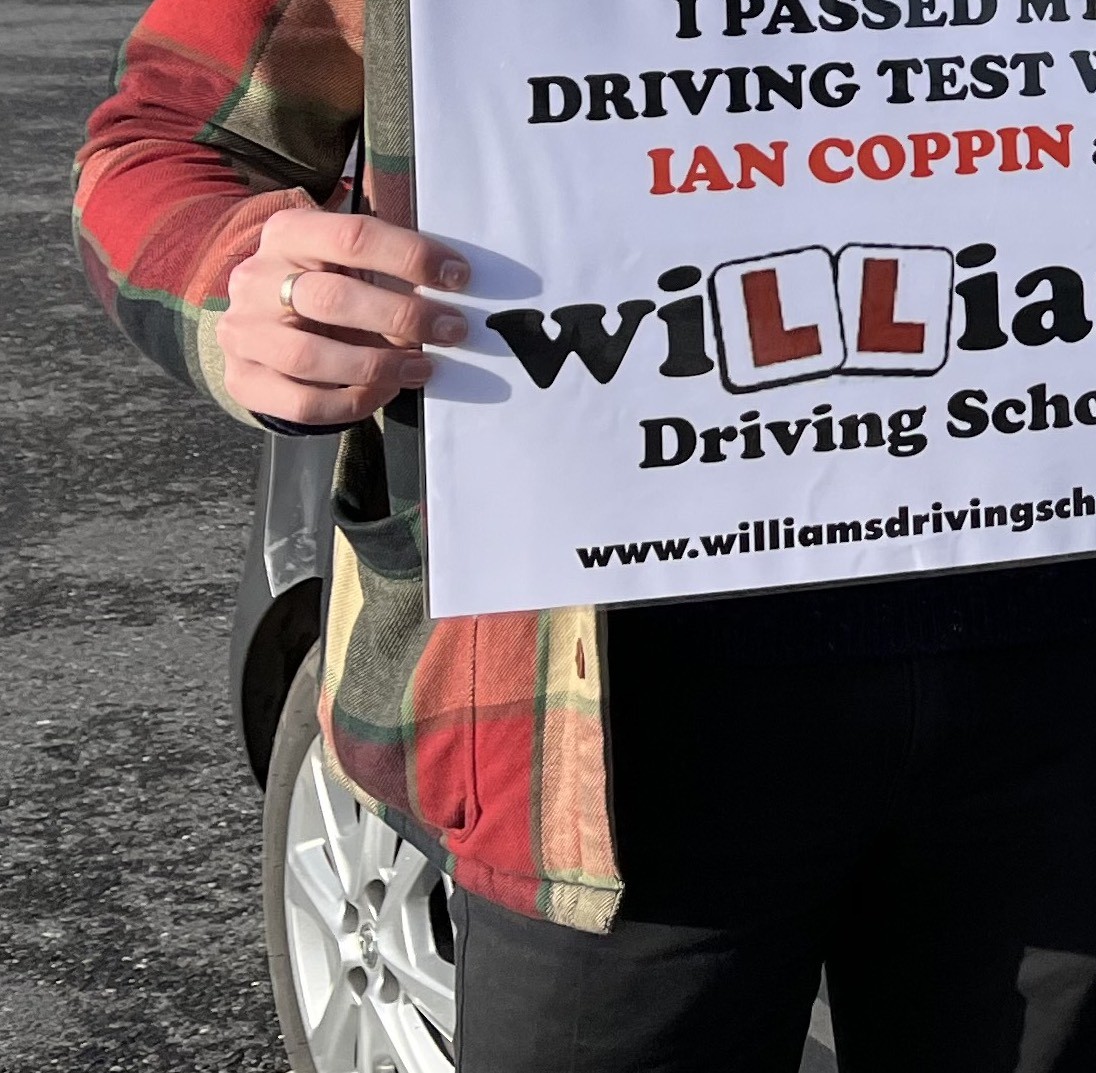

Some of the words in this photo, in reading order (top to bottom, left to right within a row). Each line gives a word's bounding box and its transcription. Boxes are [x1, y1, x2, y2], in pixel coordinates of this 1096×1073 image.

[527, 62, 861, 125] DRIVING
[876, 51, 1055, 105] TEST
[647, 141, 789, 195] IAN
[808, 124, 1074, 184] COPPIN
[638, 403, 928, 469] Driving
